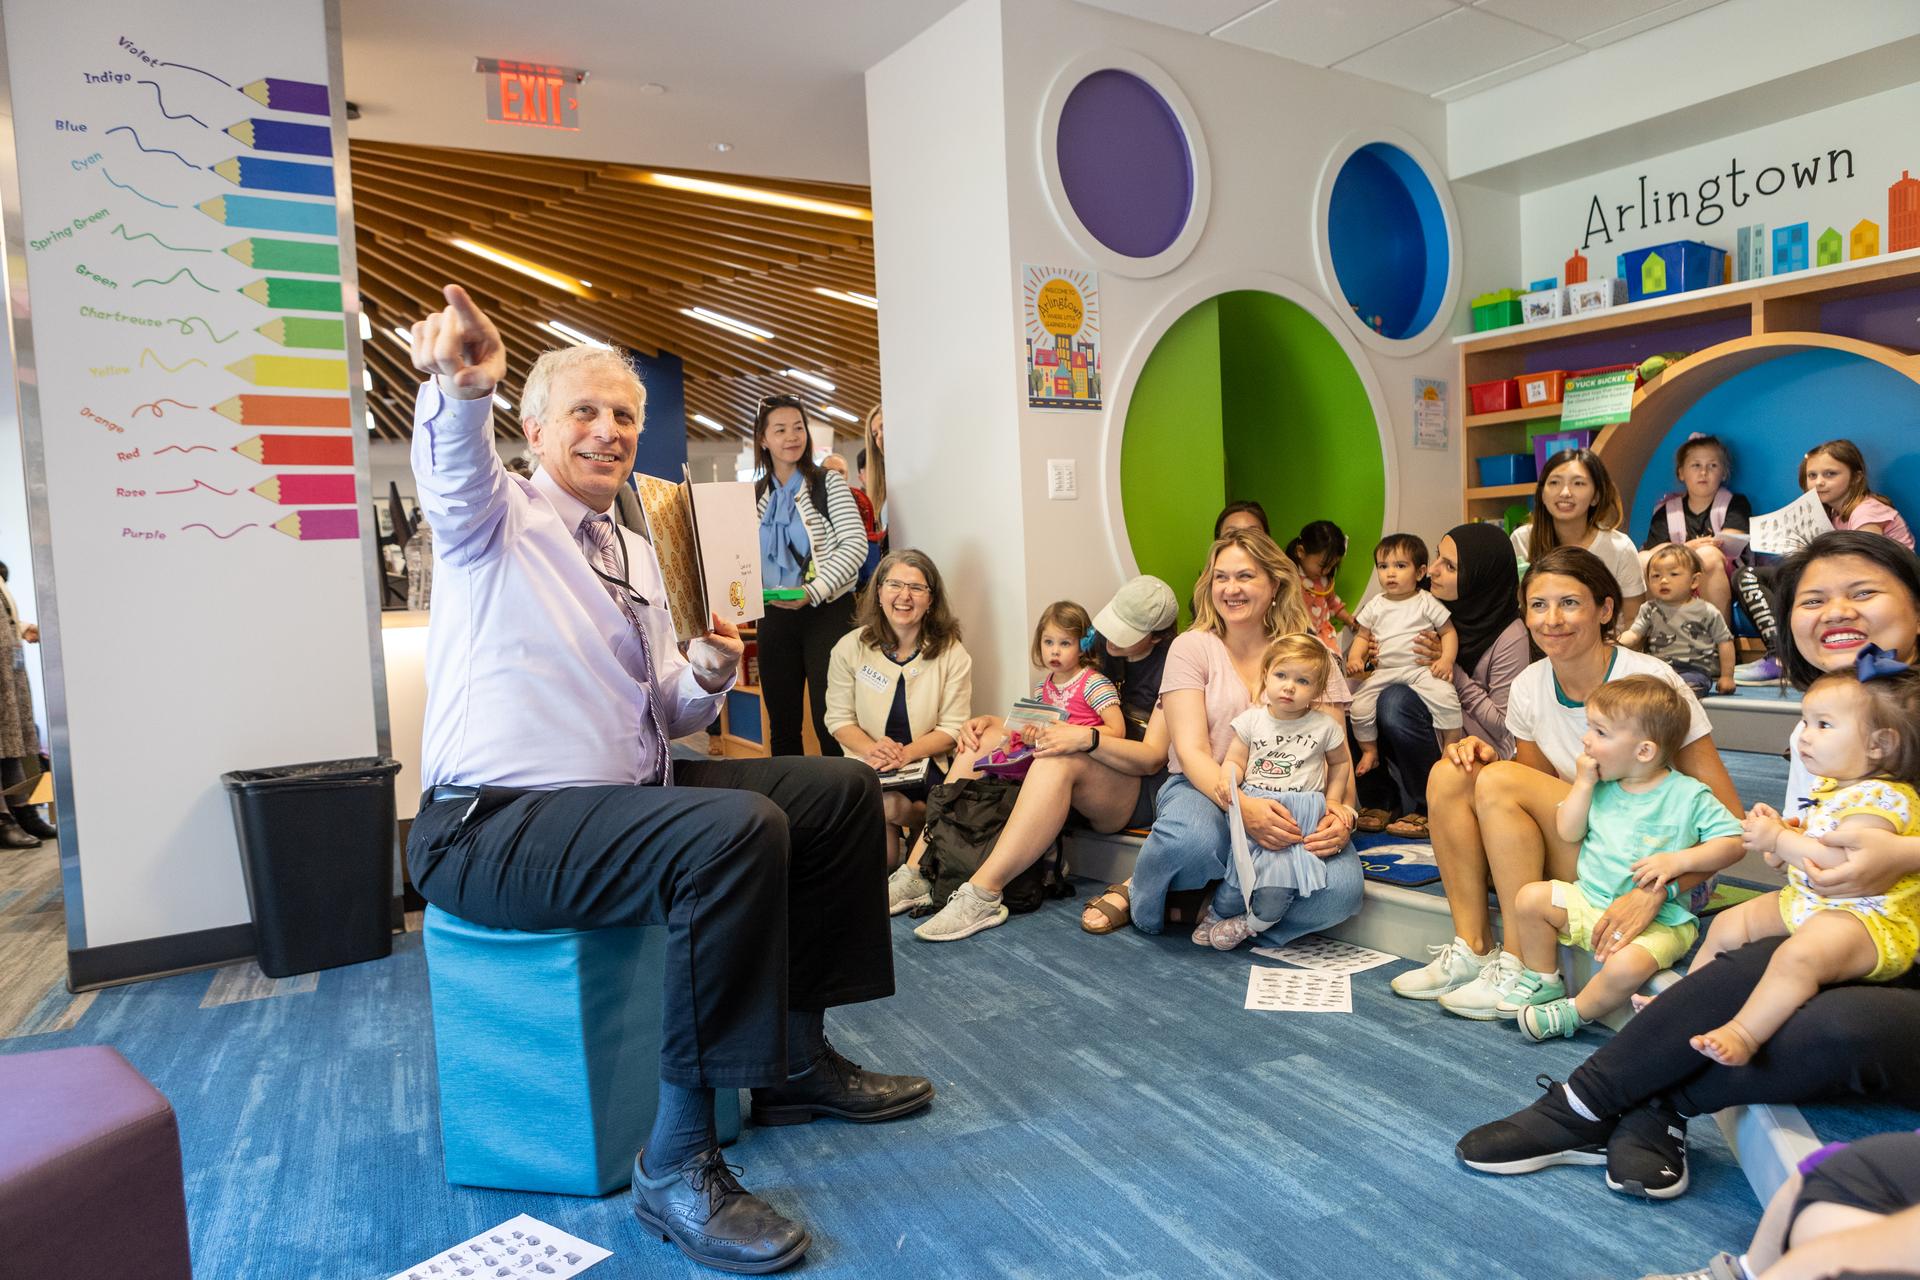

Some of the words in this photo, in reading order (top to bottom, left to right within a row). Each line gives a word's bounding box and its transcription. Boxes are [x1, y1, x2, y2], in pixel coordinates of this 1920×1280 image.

[119, 36, 158, 68] Violet
[84, 71, 132, 84] Indigo
[500, 71, 564, 125] EXIT
[55, 119, 87, 133] Blue
[70, 152, 103, 172] Cyan
[1581, 148, 1855, 250] Arlingtown
[30, 227, 72, 251] Spring
[73, 209, 110, 230] Green
[76, 264, 118, 289] Green
[1038, 294, 1082, 319] Arlingtown
[79, 306, 163, 328] Chartreuse
[89, 366, 131, 379] Yellow
[1576, 381, 1597, 389] YUCK
[1597, 375, 1625, 385] BUCKET
[80, 407, 125, 434] Orange
[117, 447, 141, 462] Red
[116, 487, 147, 498] Rose
[122, 527, 167, 541] Purple
[862, 665, 889, 685] SUSAN
